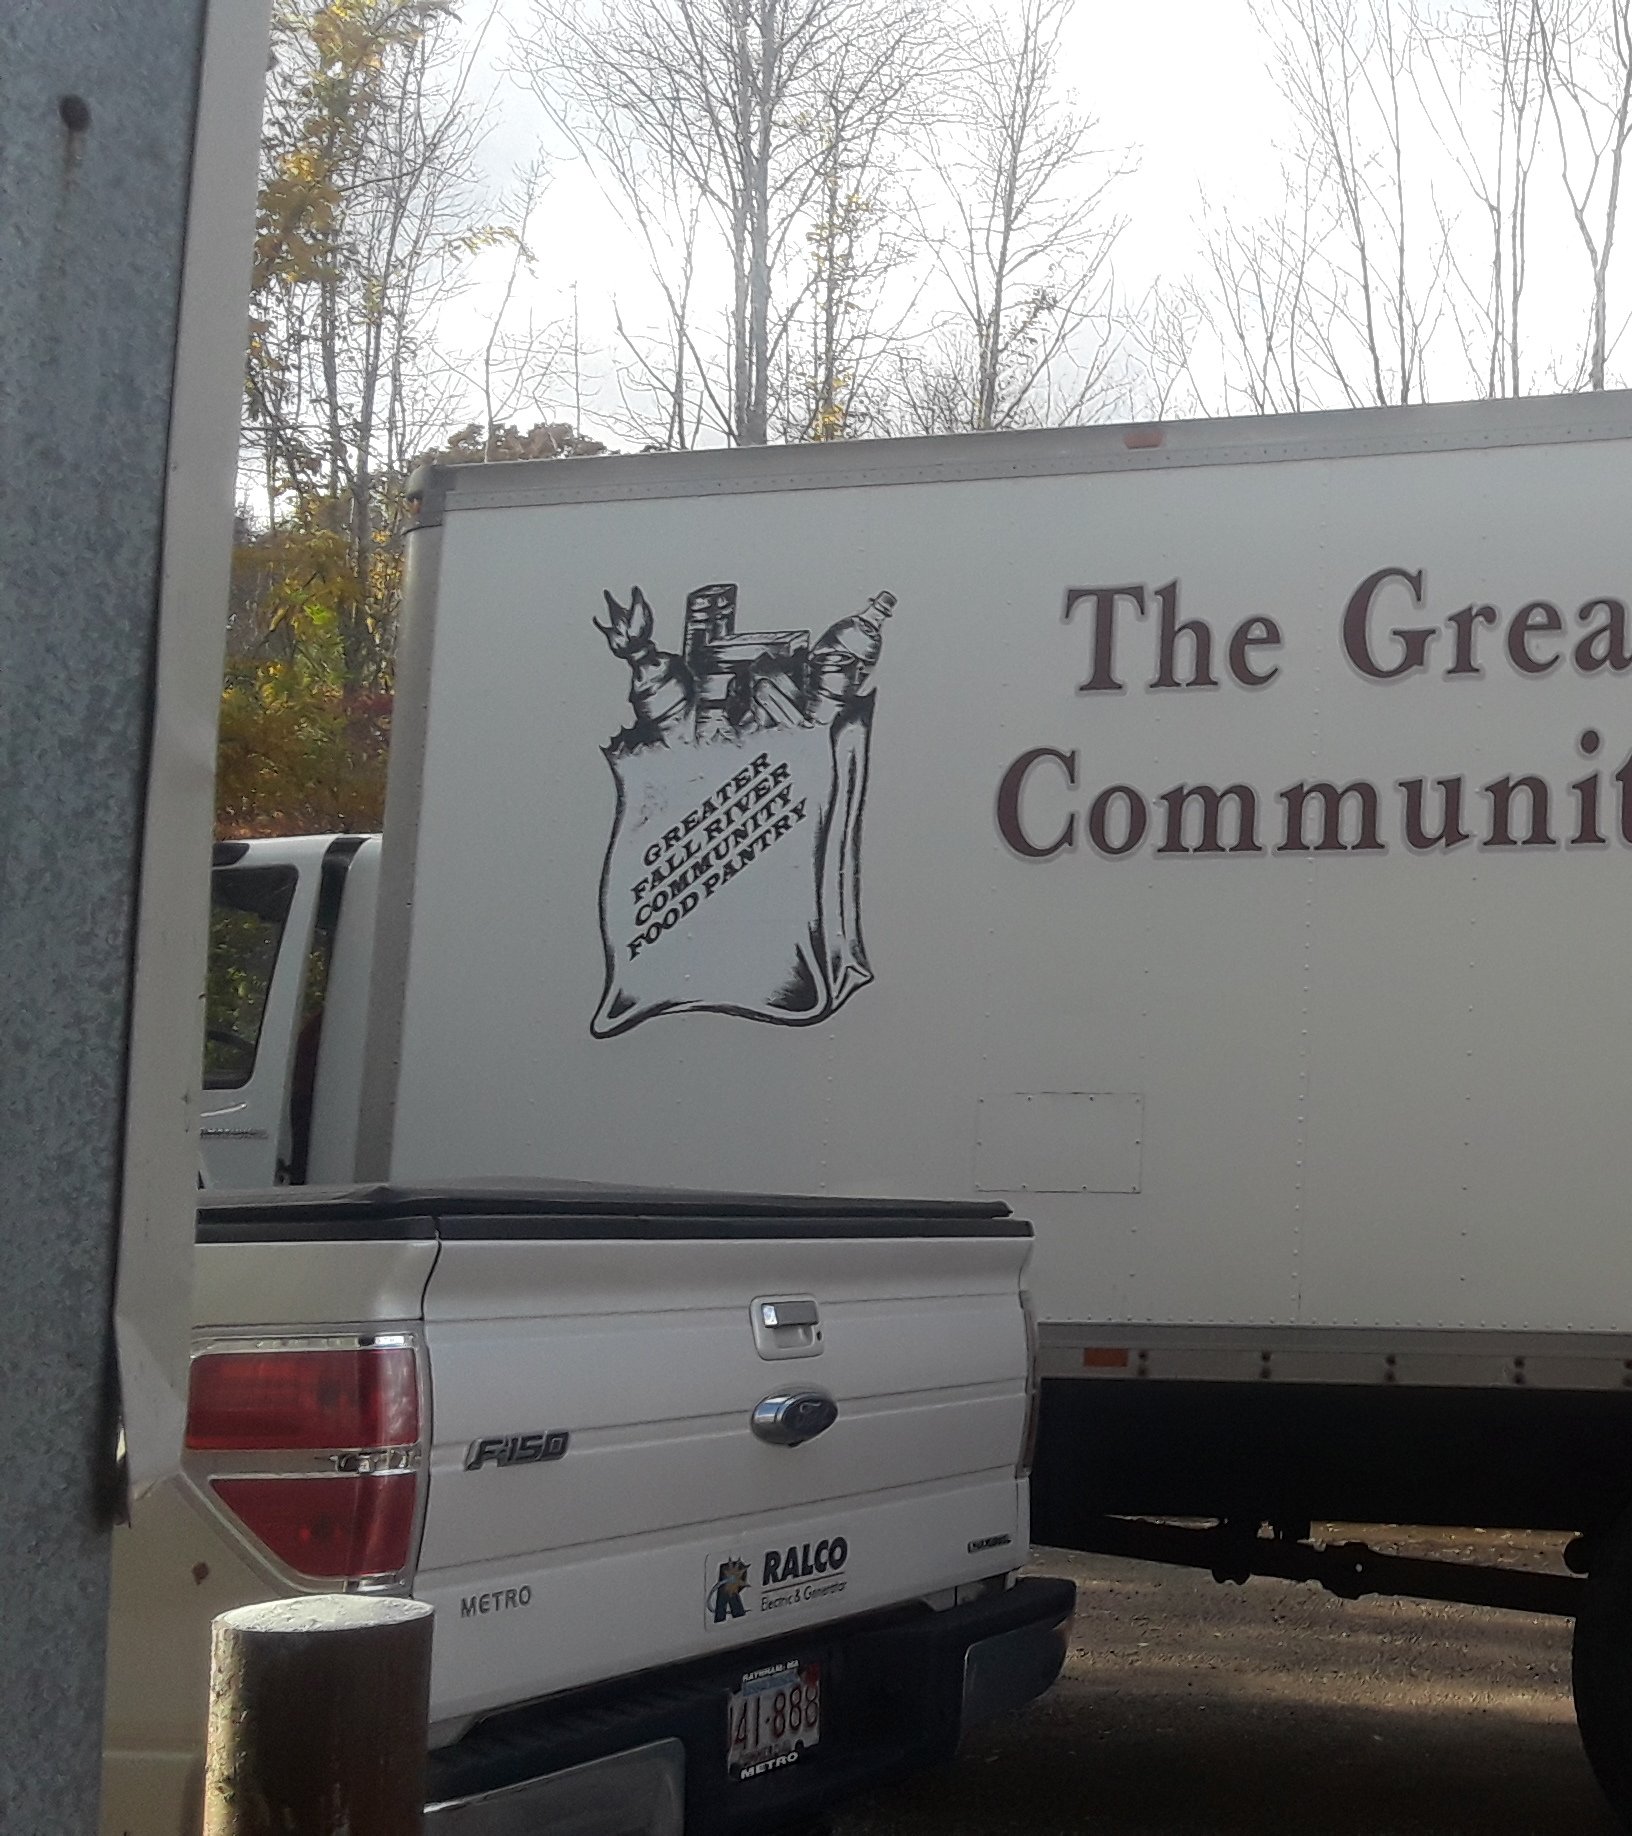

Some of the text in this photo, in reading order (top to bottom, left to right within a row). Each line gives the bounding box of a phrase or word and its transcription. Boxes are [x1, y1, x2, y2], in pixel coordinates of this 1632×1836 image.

[1062, 577, 1284, 692] The
[631, 762, 792, 904] FALL RIVER
[635, 781, 794, 927] COMMUNITY
[643, 752, 771, 866] GREATER
[626, 797, 807, 962] FOOD PANTRY
[459, 1585, 531, 1618] METRO
[762, 1536, 848, 1586] RALCO
[740, 1752, 798, 1780] METRO
